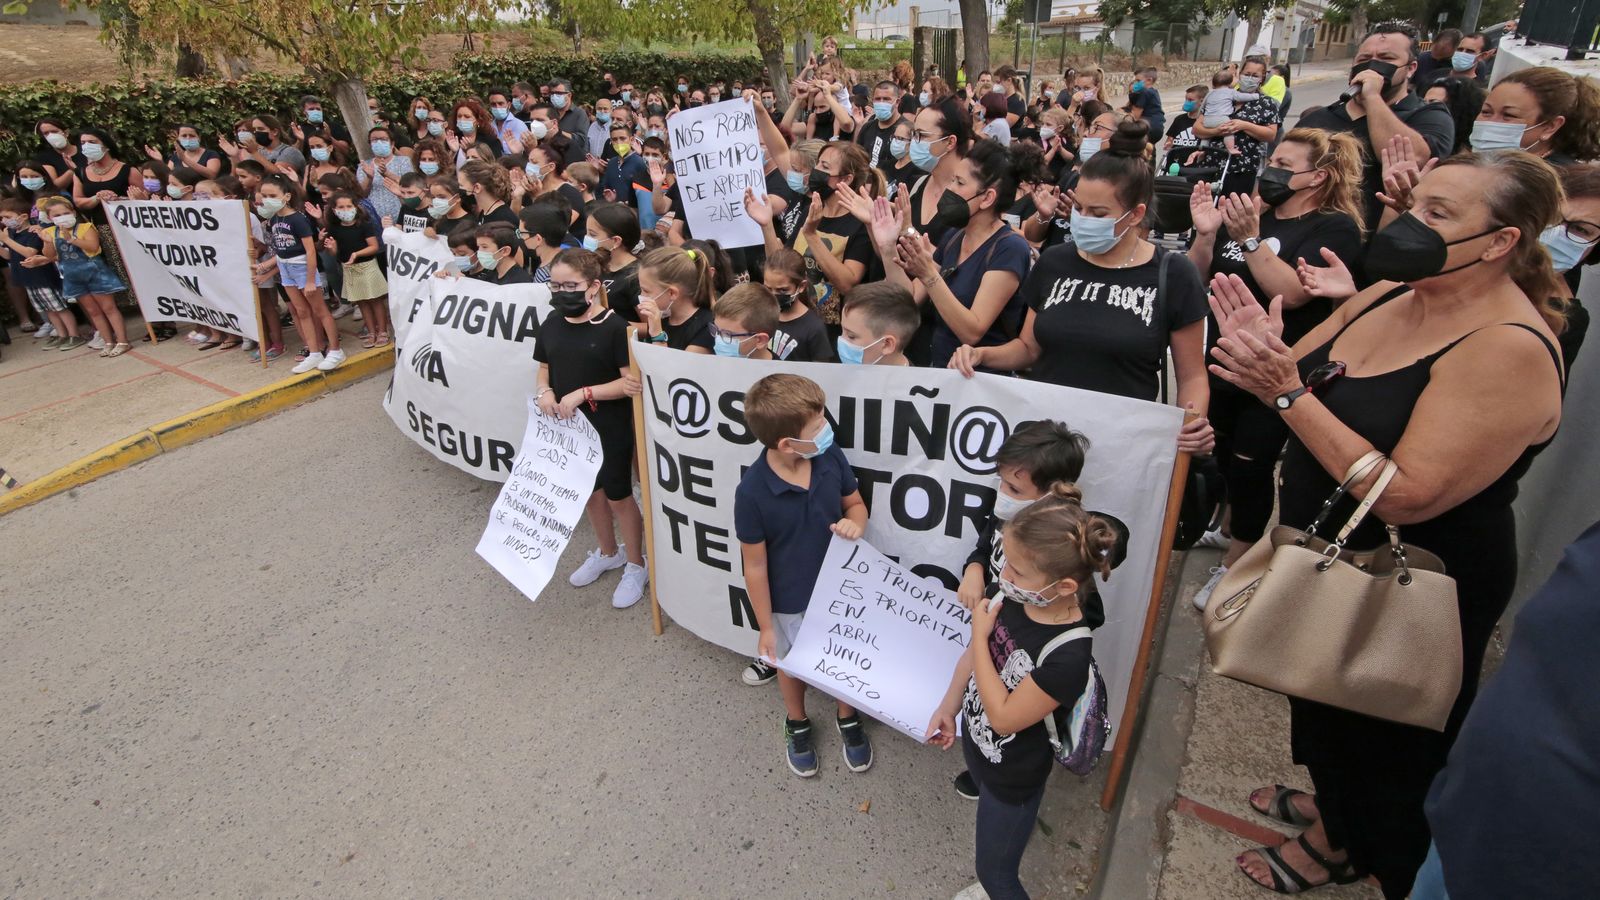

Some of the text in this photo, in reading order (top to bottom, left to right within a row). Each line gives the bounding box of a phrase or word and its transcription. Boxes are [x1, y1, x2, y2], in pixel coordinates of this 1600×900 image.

[675, 109, 757, 150] NOS ROBAN
[687, 142, 758, 172] TIEMPO
[685, 168, 765, 203] DE APRENDI
[114, 204, 220, 231] QUEREMOS
[1044, 278, 1158, 327] LET IT ROCK
[646, 374, 758, 446] L@S
[585, 446, 599, 464] DE
[509, 480, 521, 492] ES
[654, 440, 718, 508] DE
[550, 483, 580, 502] TIEMPO
[841, 544, 870, 574] LO
[839, 579, 864, 600] ES
[828, 623, 880, 651] ABRIL
[823, 637, 872, 671] JUNIO
[814, 659, 881, 700] AGOSTO
